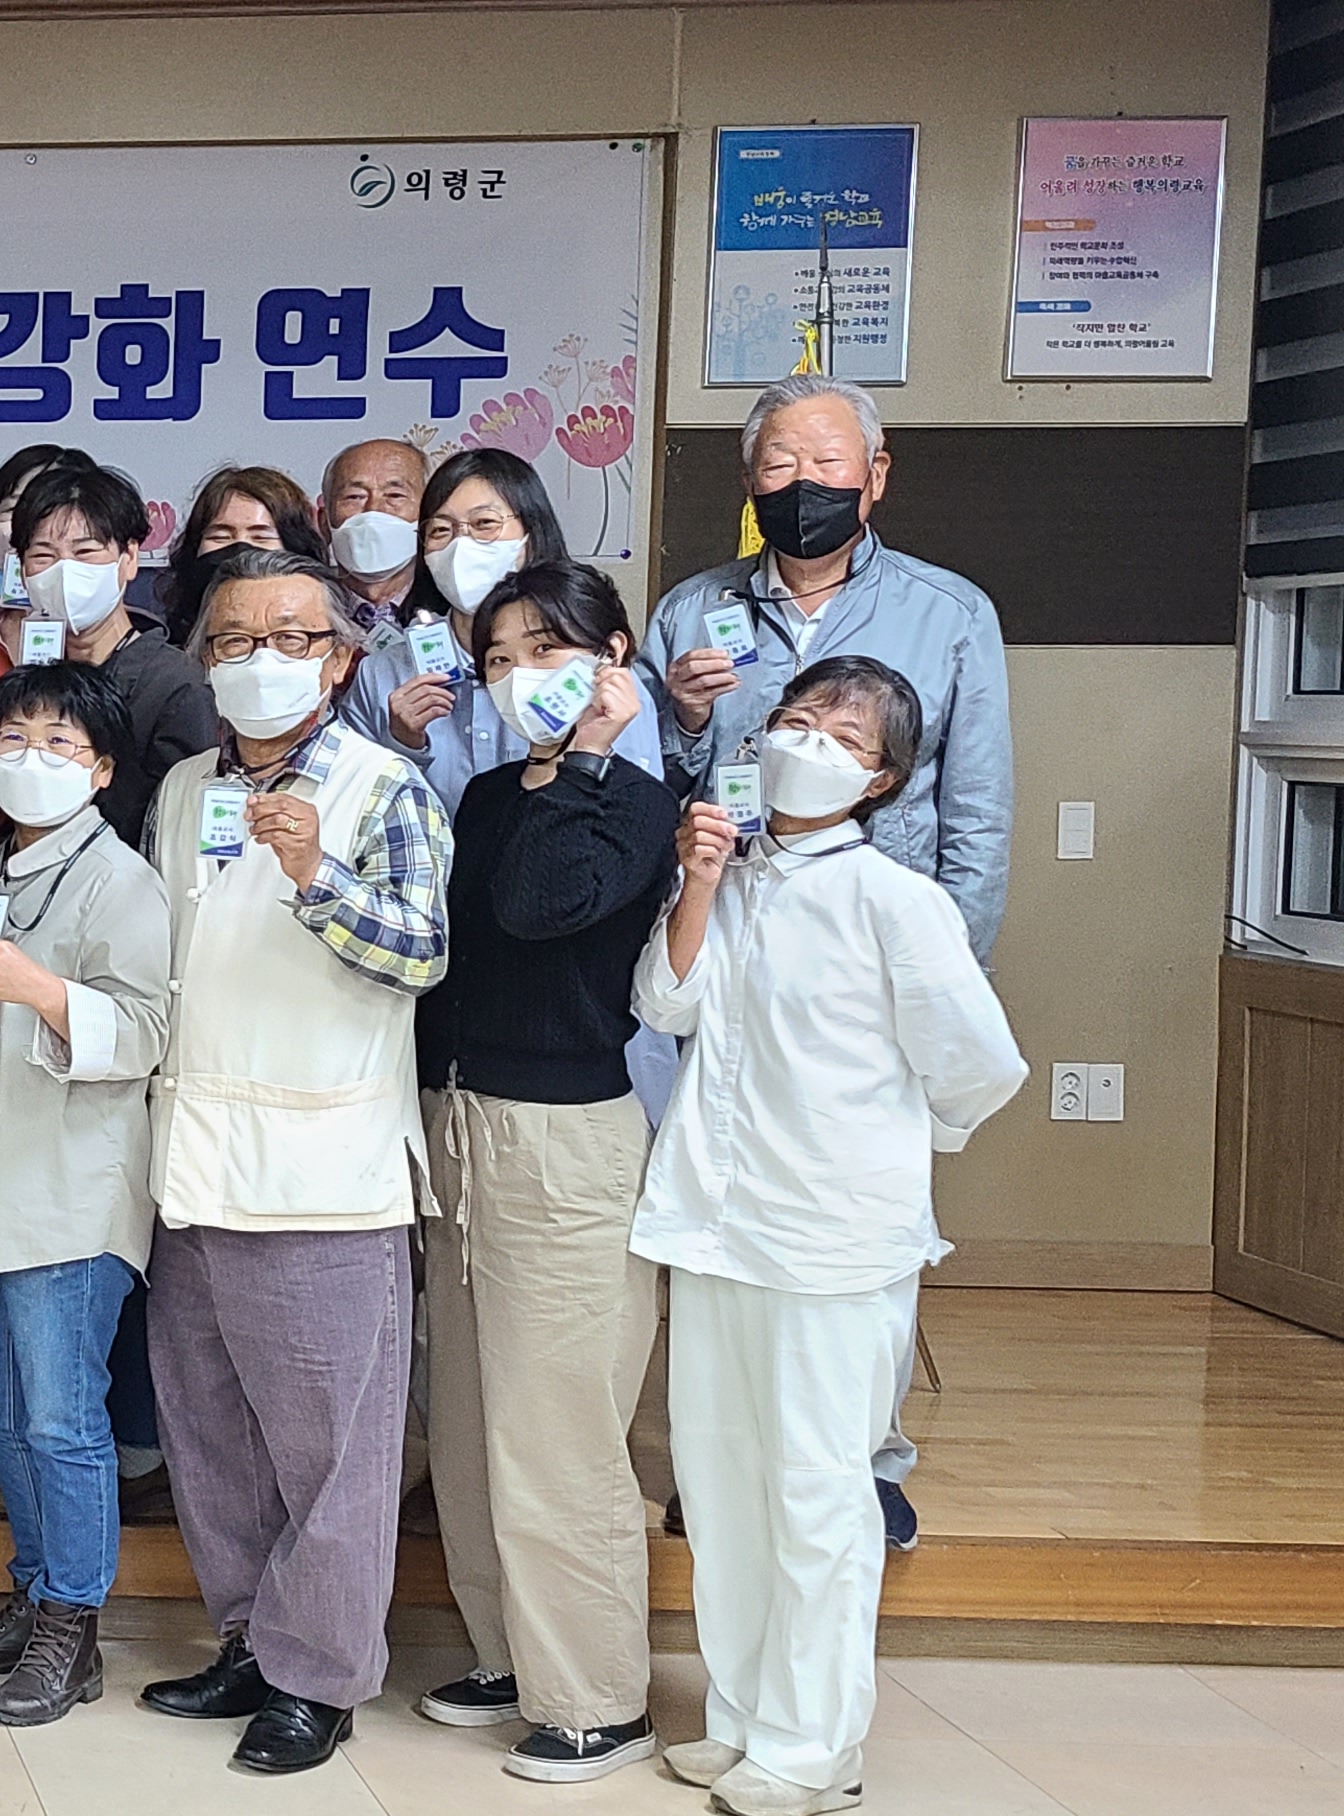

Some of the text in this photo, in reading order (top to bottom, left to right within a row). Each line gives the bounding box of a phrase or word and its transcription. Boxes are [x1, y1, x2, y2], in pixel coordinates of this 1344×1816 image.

[1161, 154, 1185, 169] 학교
[404, 169, 507, 200] 의령군
[1132, 178, 1205, 194] 행복의령교육
[255, 285, 509, 422] 연수
